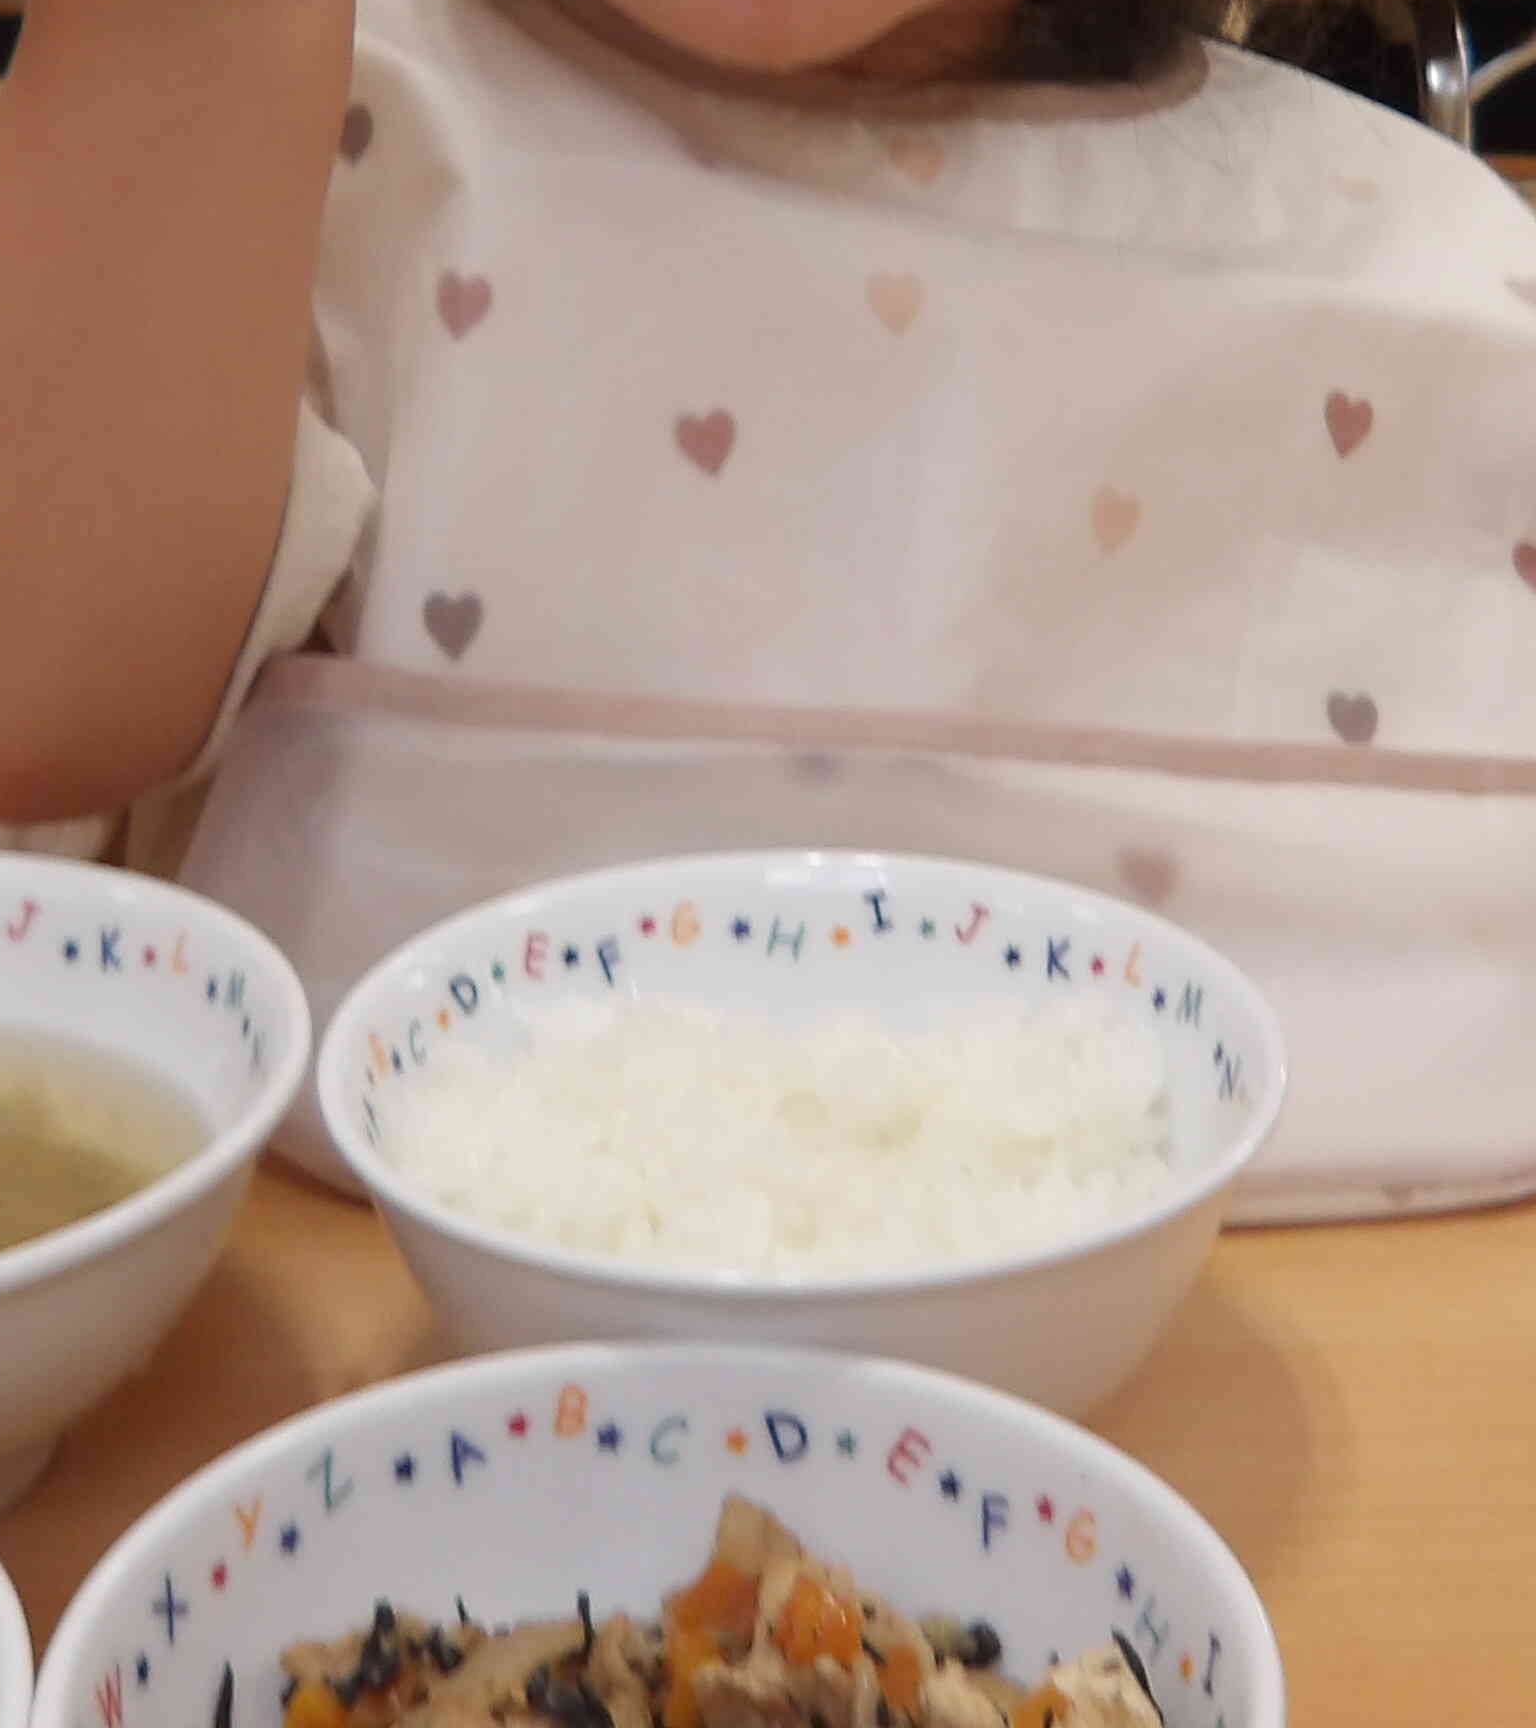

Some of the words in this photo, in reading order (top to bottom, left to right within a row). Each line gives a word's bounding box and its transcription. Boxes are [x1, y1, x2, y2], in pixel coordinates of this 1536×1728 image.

[7, 899, 41, 943] J
[99, 925, 124, 973] K
[448, 971, 479, 1018] D
[522, 930, 550, 980] E
[765, 913, 807, 963] H
[861, 886, 892, 936] I
[953, 900, 990, 946] J
[1045, 933, 1073, 984] K
[1121, 938, 1145, 988] L
[233, 1495, 264, 1550] Y
[303, 1444, 358, 1517] Z
[447, 1426, 490, 1489] A
[552, 1382, 591, 1442] B
[649, 1411, 691, 1470] C
[763, 1407, 811, 1467] D
[885, 1424, 934, 1489] E
[979, 1490, 1012, 1555] F
[1064, 1505, 1099, 1568] G
